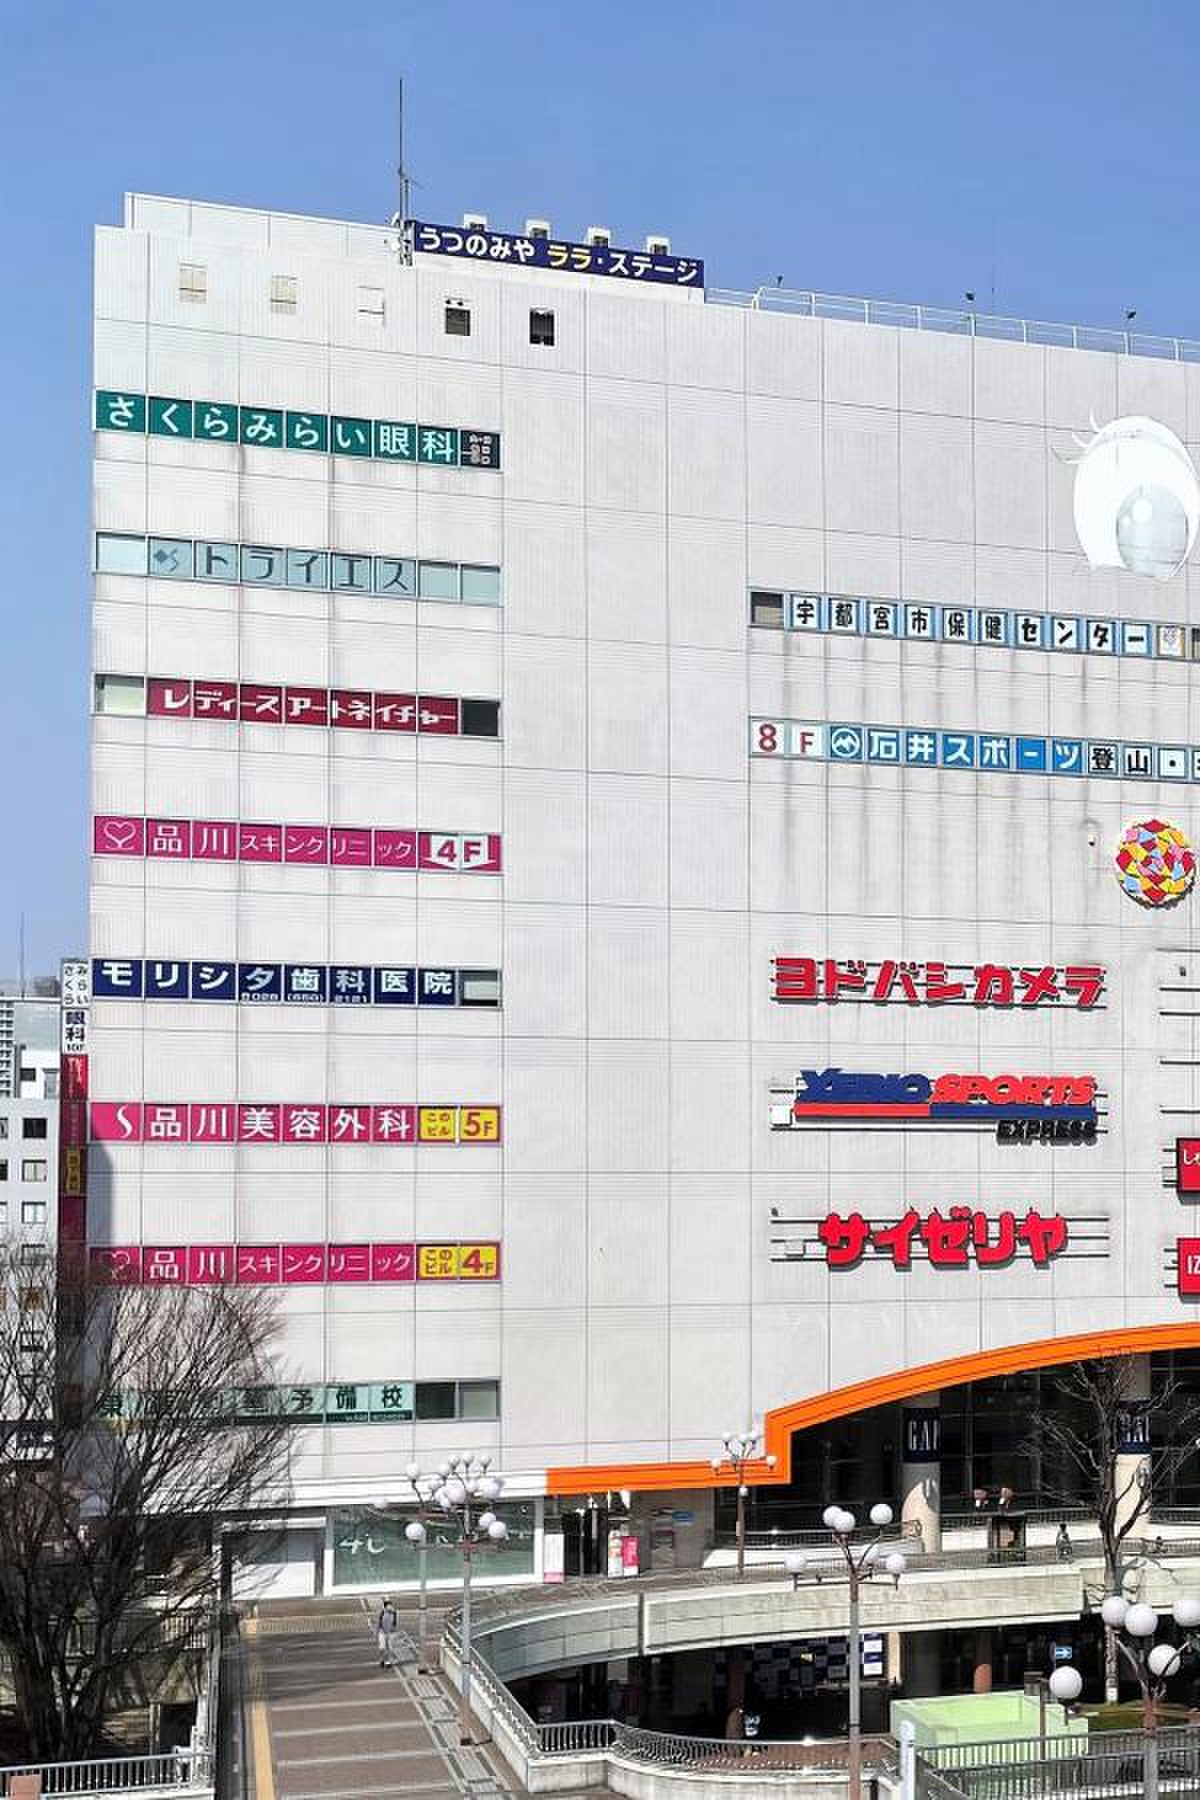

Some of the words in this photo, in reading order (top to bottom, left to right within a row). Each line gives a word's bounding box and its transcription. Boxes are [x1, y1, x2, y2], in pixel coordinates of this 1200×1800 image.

[420, 227, 535, 262] うつのみや
[547, 245, 697, 282] ララ・ステージ
[107, 395, 455, 463] さくらみらい眼科
[204, 546, 409, 592] トライエス
[795, 598, 1146, 650] 宇都宮市保健センター
[162, 687, 457, 726] レディースアートネイチャー
[868, 730, 1080, 770] 石井スポーツ
[152, 824, 413, 861] 品川スキンクリニック
[435, 837, 484, 864] 4F
[101, 963, 452, 995] モリシタ歯科医院
[775, 957, 1103, 1007] ヨドバシカメラ
[801, 1069, 931, 1103] XEBIO
[931, 1073, 1097, 1104] SPORTS
[151, 1107, 411, 1140] 品川美容外科
[464, 1112, 495, 1138] 5F
[997, 1120, 1097, 1146] EXPRESS
[818, 1206, 1067, 1271] サイゼリヤ
[150, 1250, 412, 1280] 品川スキンクリニック
[463, 1249, 495, 1274] 4F
